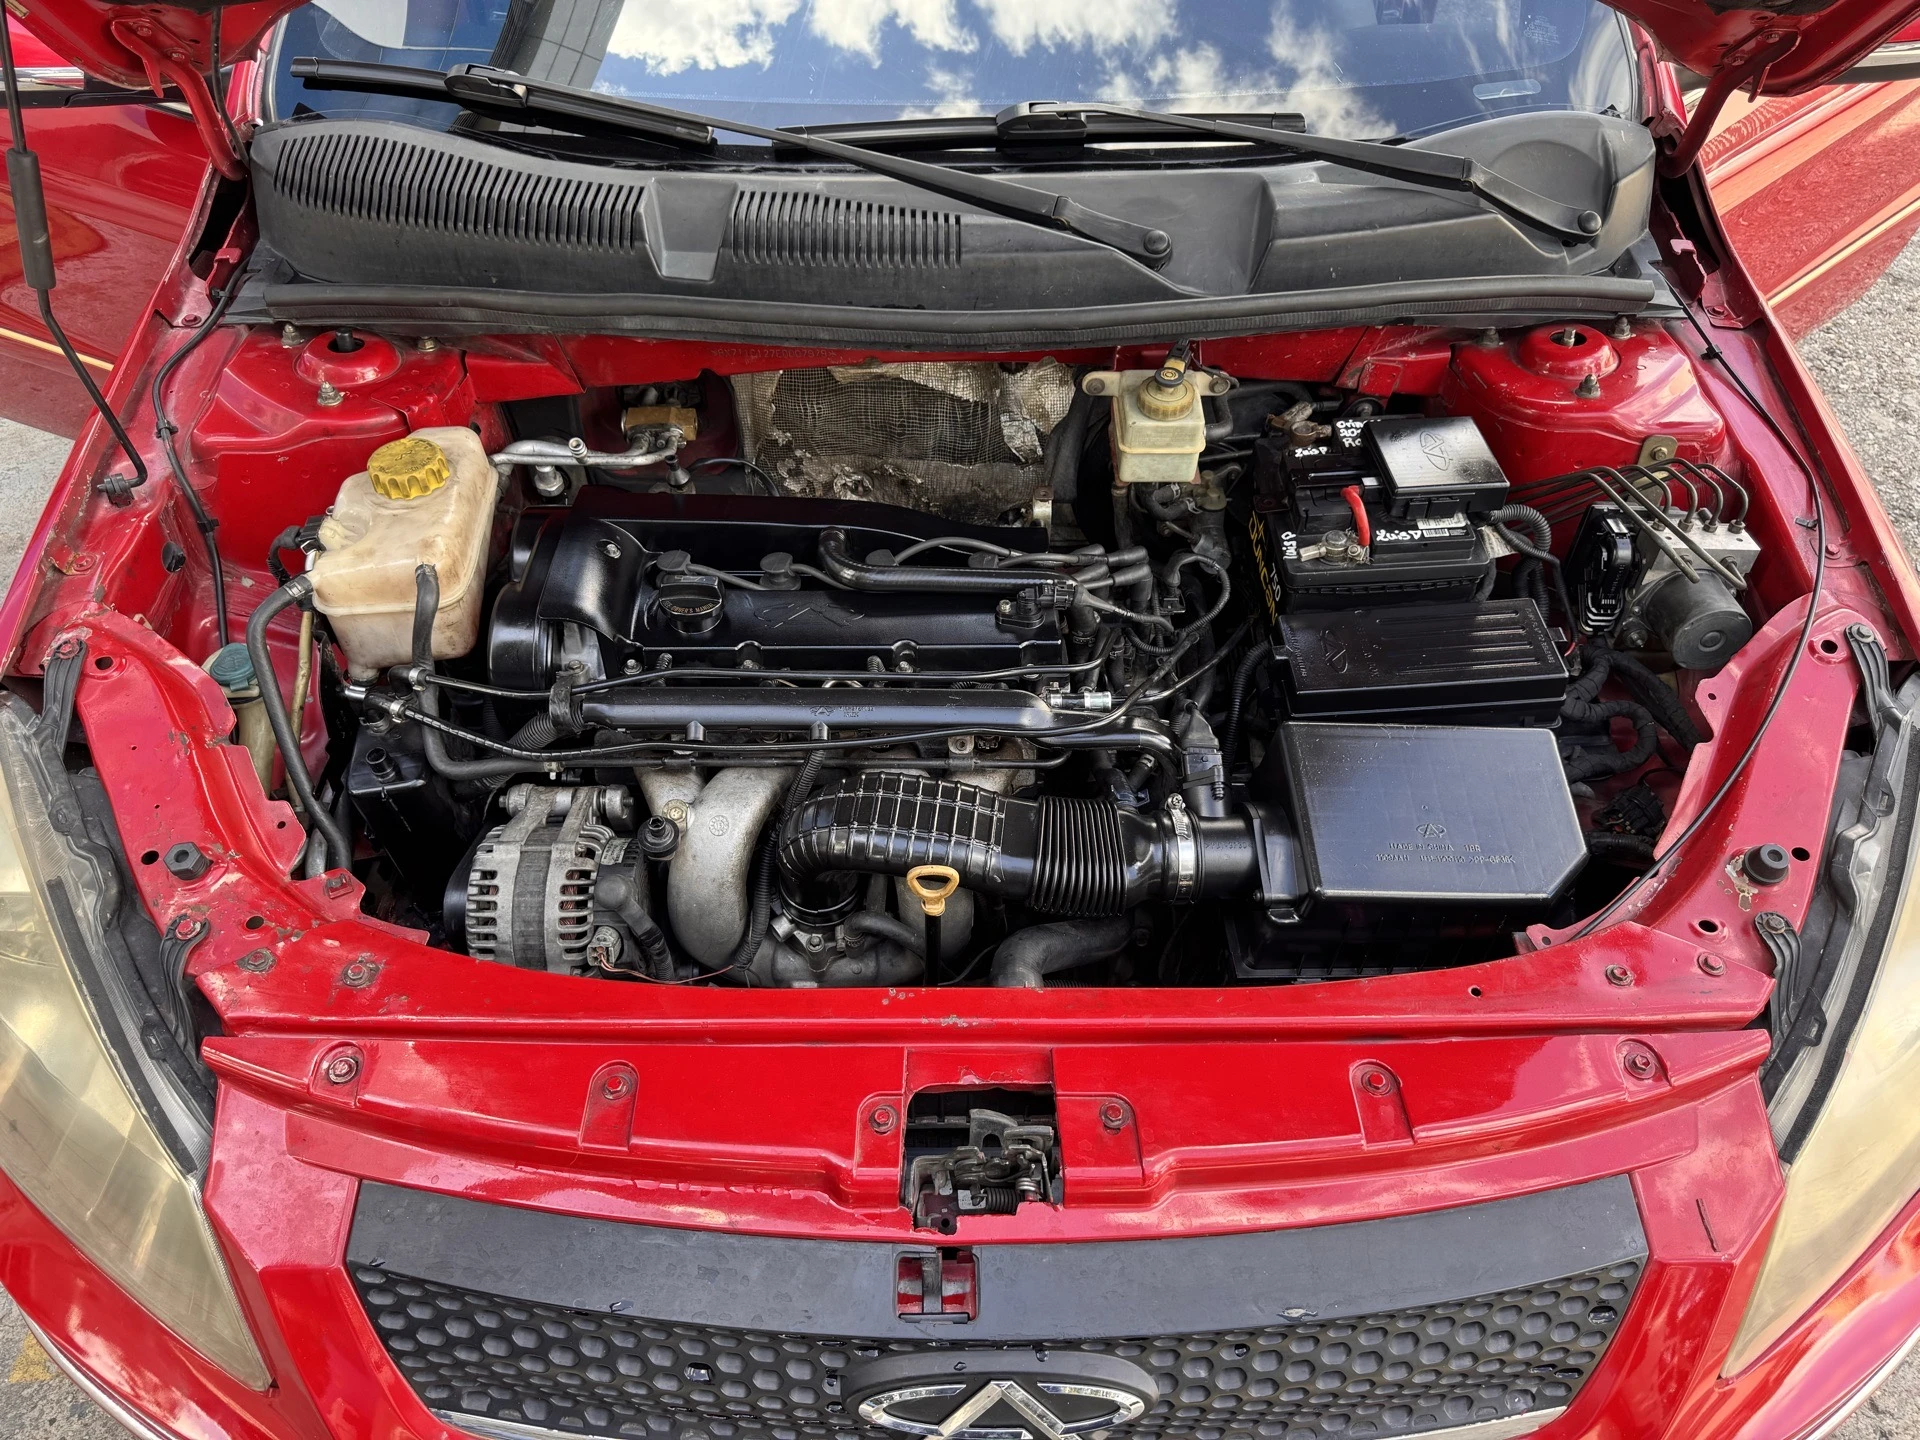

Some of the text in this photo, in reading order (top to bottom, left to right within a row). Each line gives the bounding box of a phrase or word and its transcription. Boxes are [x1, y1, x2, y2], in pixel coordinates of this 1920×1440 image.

[1270, 562, 1282, 602] 750
[1389, 842, 1413, 851] MADE
[1427, 843, 1455, 852] CHINA
